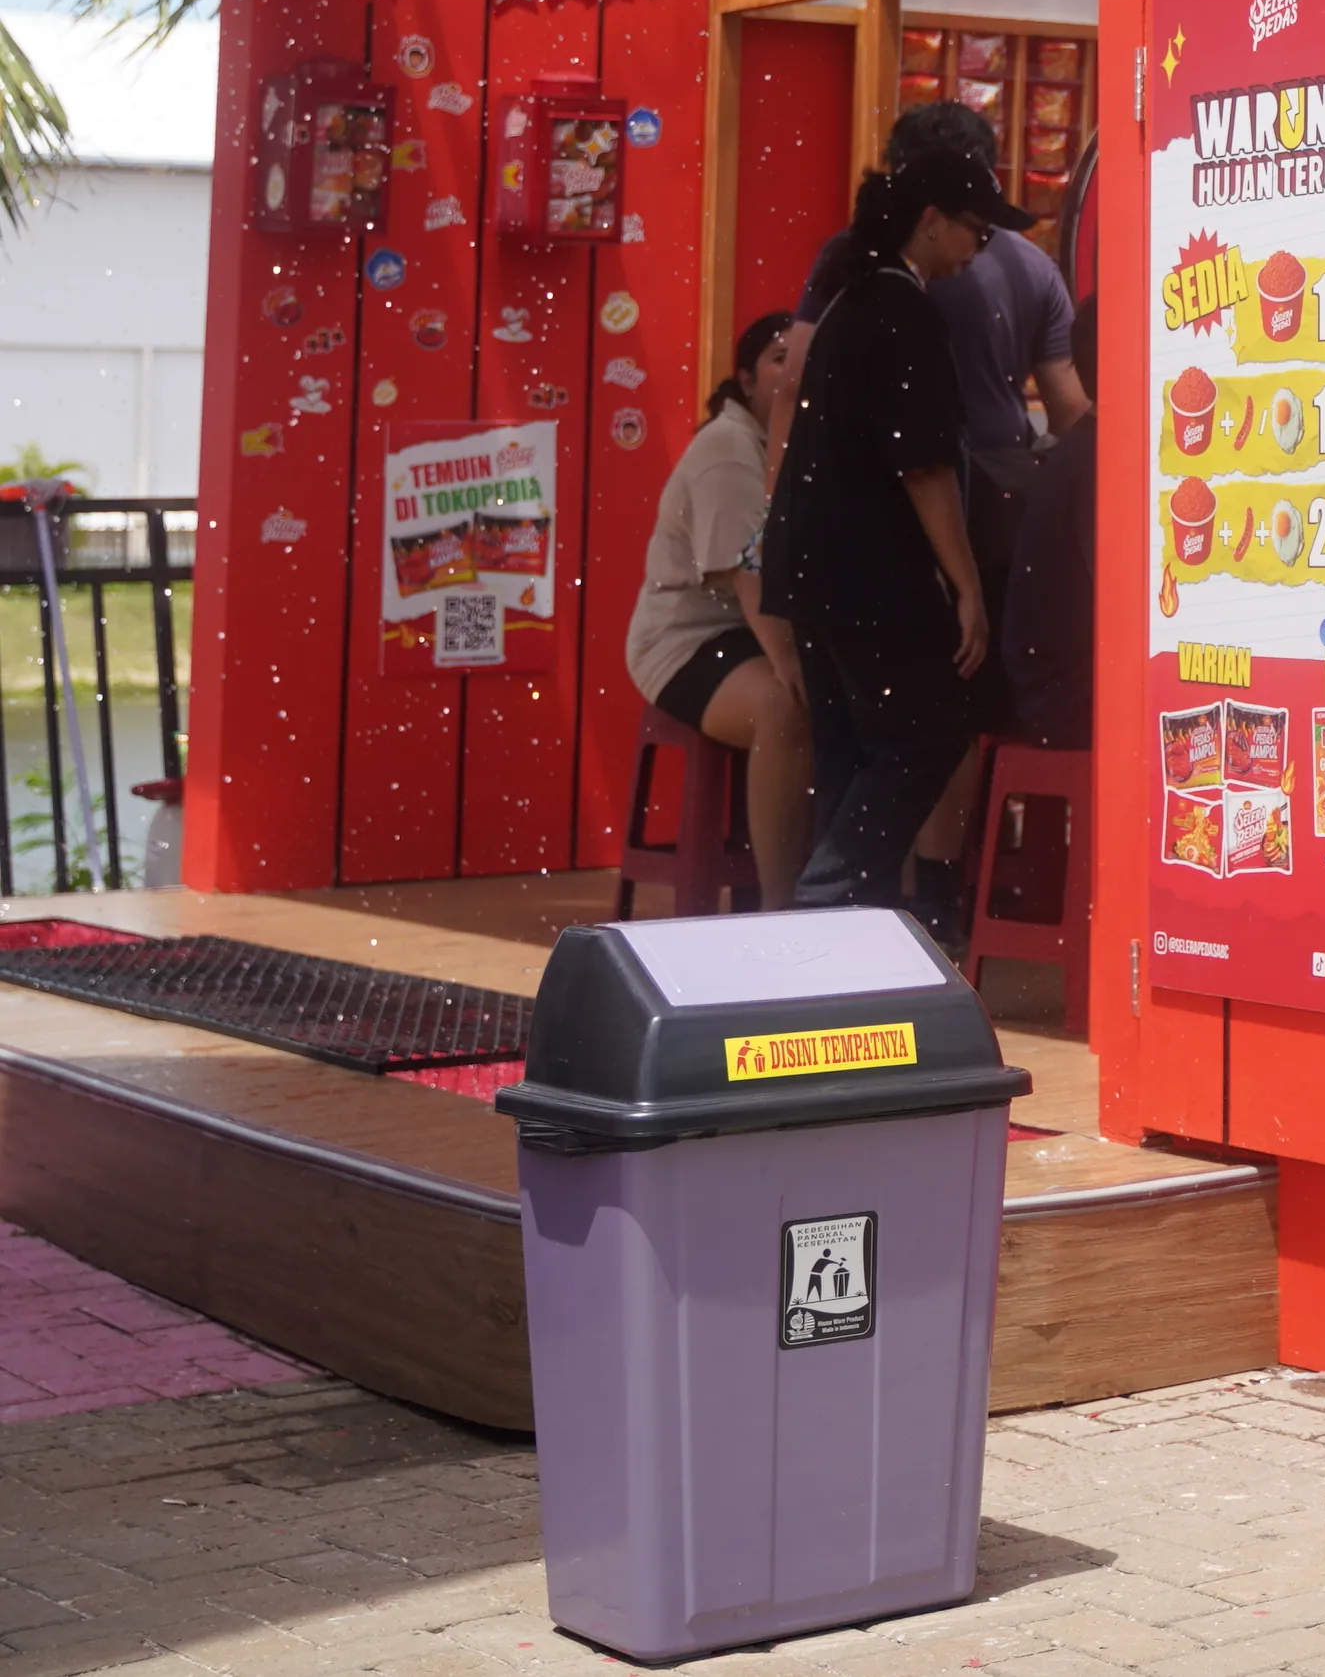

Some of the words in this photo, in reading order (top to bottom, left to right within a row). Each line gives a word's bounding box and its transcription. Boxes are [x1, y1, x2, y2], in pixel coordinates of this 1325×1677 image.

[1252, 3, 1298, 52] PEDAS
[1195, 160, 1274, 206] HUJAN
[1162, 245, 1250, 331] SEDIA
[408, 454, 492, 490] TEMUIN
[394, 496, 419, 522] DI
[422, 476, 542, 517] TOKOPEDIA
[1178, 641, 1251, 688] VARIAN
[1235, 806, 1266, 830] SELERA
[1236, 821, 1265, 849] PEDAS
[769, 1037, 819, 1069] DISINI
[821, 1030, 909, 1064] TEMPATNYA
[797, 1221, 862, 1235] KEBERSIHAN
[797, 1231, 844, 1242] PANGKAL
[797, 1235, 857, 1248] KESEHATAN
[846, 1315, 864, 1323] Product
